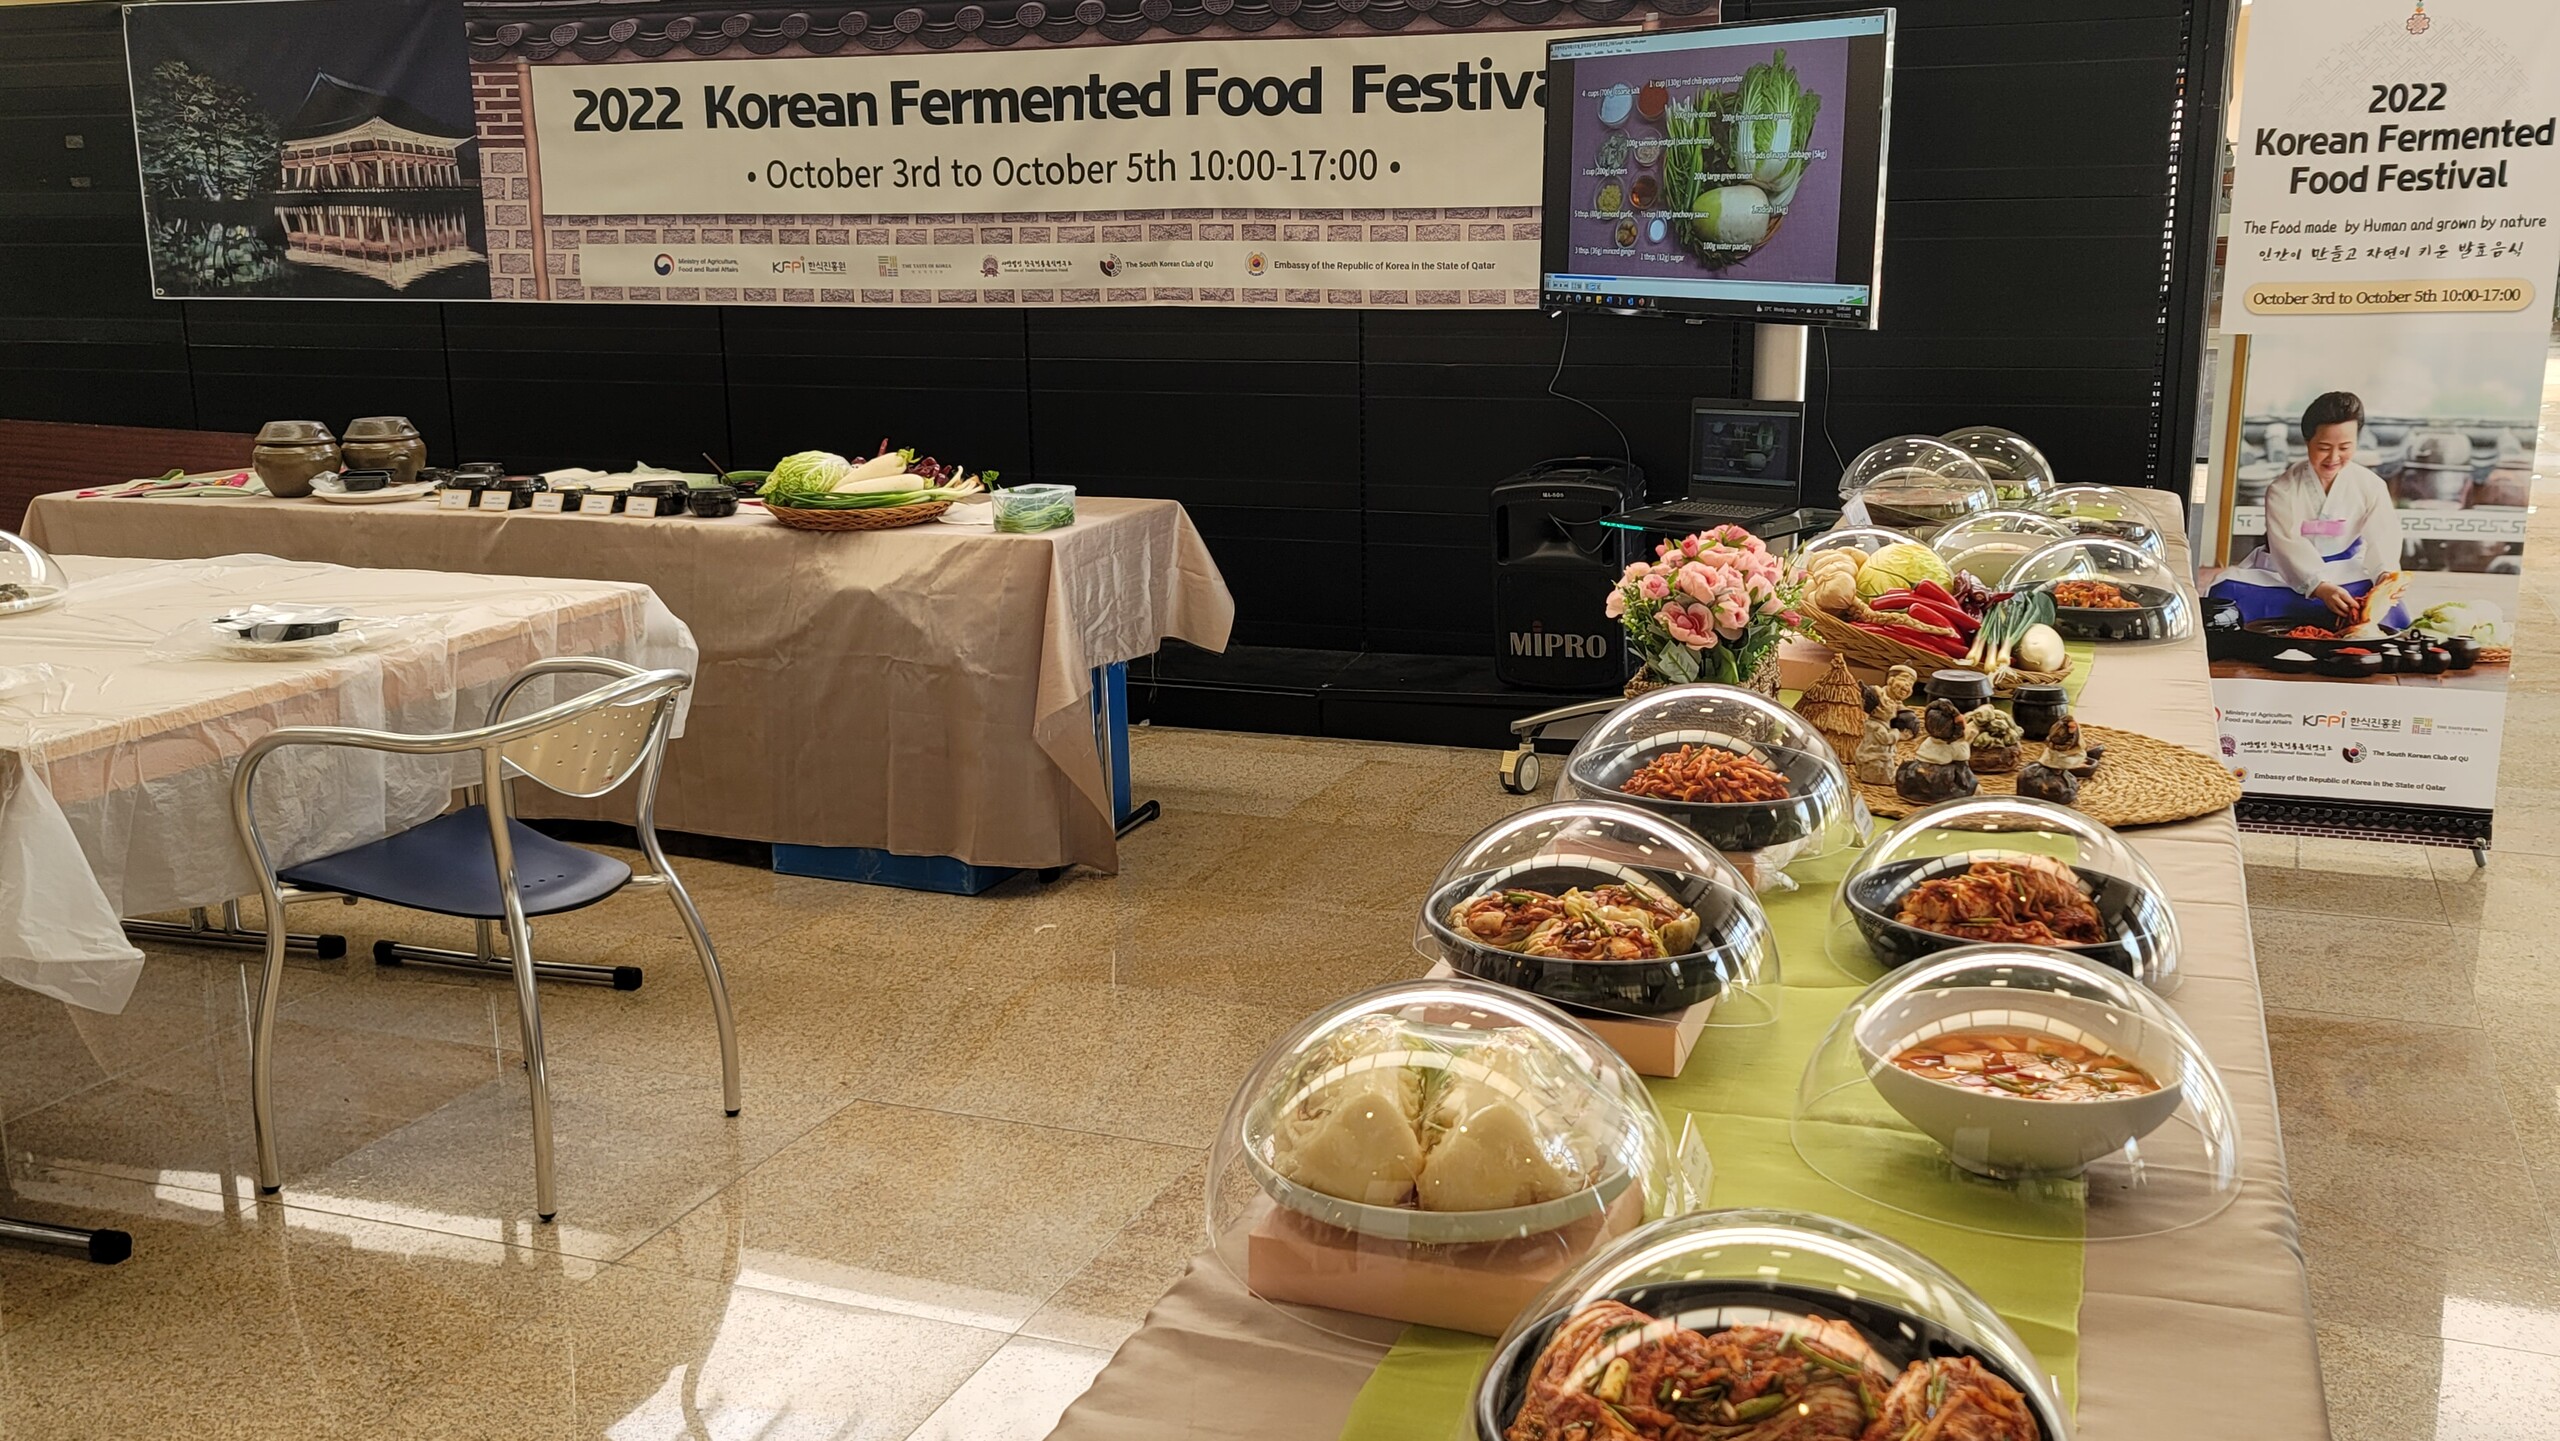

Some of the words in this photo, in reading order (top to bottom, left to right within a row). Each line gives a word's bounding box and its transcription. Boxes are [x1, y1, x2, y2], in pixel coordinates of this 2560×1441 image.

[1702, 77, 1721, 86] pepper
[1722, 75, 1743, 84] powder
[573, 87, 683, 132] 2022
[704, 85, 878, 129] Korean
[890, 70, 1171, 126] Fermented
[1186, 66, 1323, 117] Food
[1352, 57, 1546, 114] Festiv
[2368, 82, 2448, 113] 2022
[2255, 127, 2369, 156] Korean
[2378, 117, 2557, 152] Fermented
[1787, 151, 1811, 160] cabbage
[766, 158, 884, 190] October
[893, 157, 941, 189] 3rd
[951, 161, 982, 187] to
[992, 153, 1118, 187] October
[1126, 150, 1177, 184] 5th
[1189, 148, 1378, 182] 10:00-17:00
[1610, 168, 1627, 176] oysters
[1707, 172, 1720, 182] large
[1720, 173, 1736, 182] green
[2289, 164, 2370, 194] Food
[2377, 160, 2508, 192] Festival
[1620, 210, 1633, 219] garlic
[1672, 210, 1694, 219] anchovy
[2244, 220, 2267, 234] The
[2270, 221, 2301, 234] Food
[2305, 221, 2337, 234] made
[2345, 220, 2360, 235] by
[2363, 218, 2407, 233] Human
[2411, 218, 2433, 232] and
[2436, 218, 2476, 233] grown
[2481, 215, 2496, 230] by
[2500, 215, 2547, 228] nature
[1731, 242, 1752, 252] parsley
[1670, 255, 1684, 263] sugar
[2259, 247, 2301, 262] 인간이
[2311, 246, 2357, 263] 만들고
[2366, 245, 2410, 260] 자연이
[2418, 244, 2449, 260] 키운
[678, 258, 699, 266] Ministry
[808, 261, 847, 272] 한식진흥원
[1139, 260, 1158, 268] South
[1159, 260, 1180, 268] Korean
[1181, 260, 1195, 268] Club
[1203, 260, 1213, 268] QU
[1274, 261, 1310, 270] Embassy
[1311, 261, 1320, 269] of
[1322, 261, 1335, 269] the
[1337, 261, 1374, 271] Republic
[1375, 261, 1384, 270] of
[1385, 262, 1409, 270] Korea
[1411, 262, 1420, 270] in
[1421, 262, 1435, 270] the
[1436, 262, 1459, 270] State
[1460, 261, 1470, 270] of
[1471, 262, 1496, 270] Qatar
[2253, 290, 2309, 305] October
[2312, 290, 2335, 304] 3rd
[2338, 293, 2353, 304] to
[2356, 289, 2411, 304] October
[2414, 288, 2437, 303] 5th
[2441, 288, 2521, 303] 10:00-17:00
[2350, 717, 2401, 730] 한식진흥원
[2372, 749, 2385, 757] The
[2407, 752, 2431, 760] Korean
[2433, 753, 2448, 761] Club
[2254, 772, 2285, 781] Embassy
[2309, 776, 2340, 785] Republic
[2382, 780, 2394, 788] the
[2426, 784, 2446, 792] Qatar
